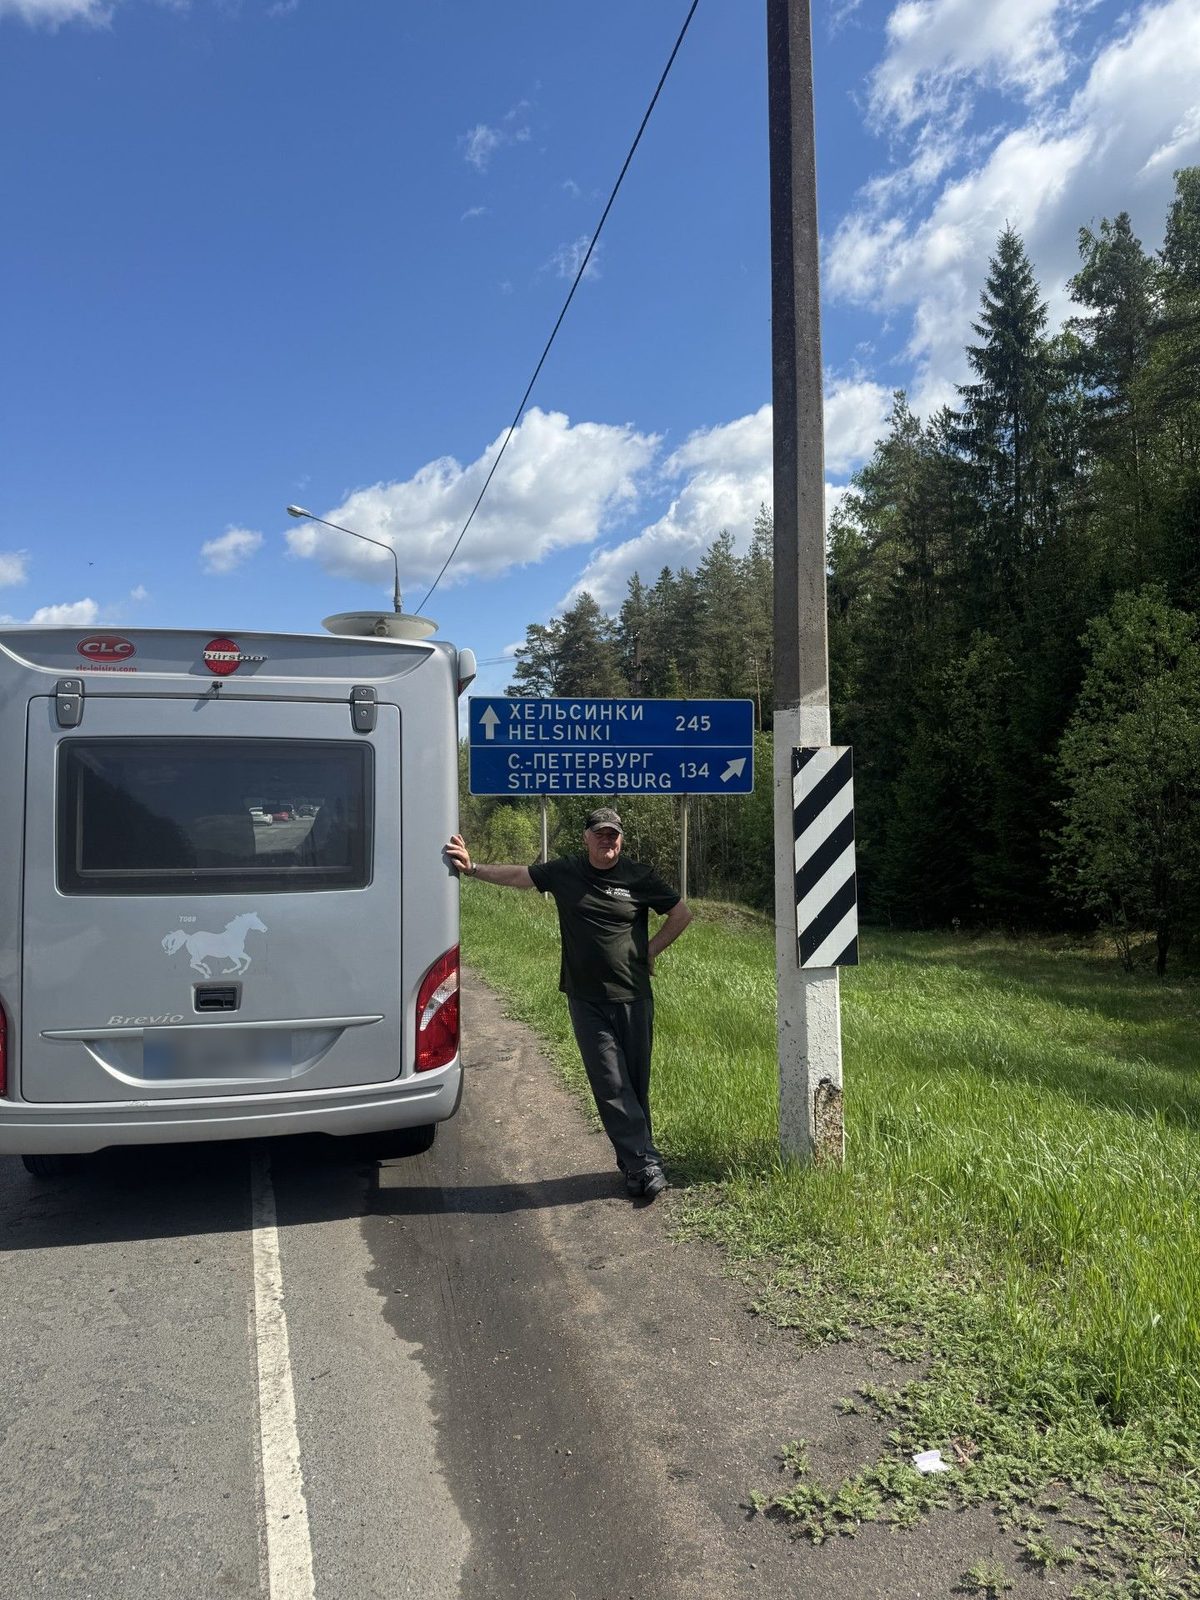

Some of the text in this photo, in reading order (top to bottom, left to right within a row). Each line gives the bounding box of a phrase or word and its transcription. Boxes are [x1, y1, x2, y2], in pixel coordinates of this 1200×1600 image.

[83, 642, 131, 653] CLC
[203, 651, 268, 662] bürstner
[509, 703, 643, 721] ХЕЛЬСИНКИ
[675, 715, 711, 732] 245
[508, 724, 610, 741] HELSINKI
[508, 753, 653, 770] С.-ПЕТЕРБУРГ
[679, 762, 710, 778] 134
[508, 773, 672, 789] ST.PETERSBURG
[107, 1013, 184, 1025] Brevio
